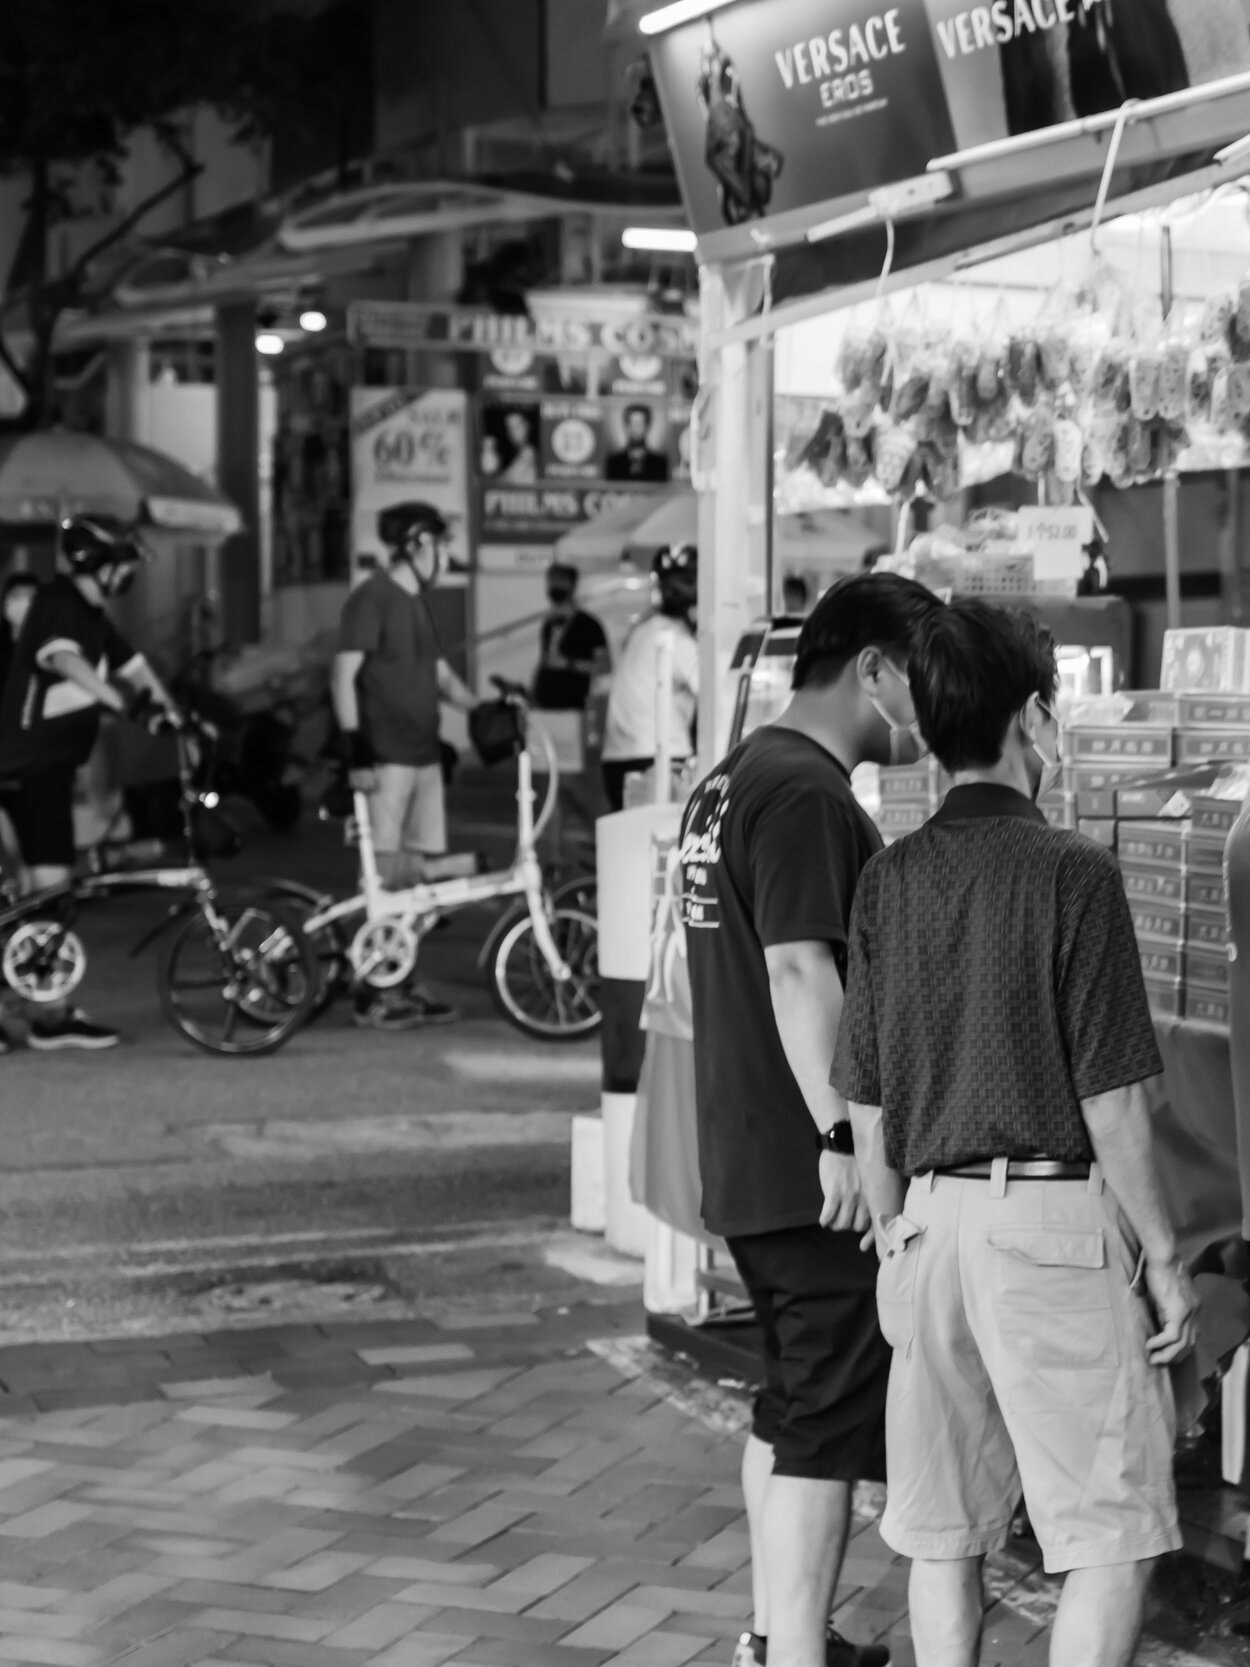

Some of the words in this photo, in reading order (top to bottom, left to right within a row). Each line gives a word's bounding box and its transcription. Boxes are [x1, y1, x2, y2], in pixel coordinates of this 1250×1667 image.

[774, 7, 907, 90] VERSACE
[936, 0, 1076, 60] VERSACE
[819, 68, 875, 109] EROS
